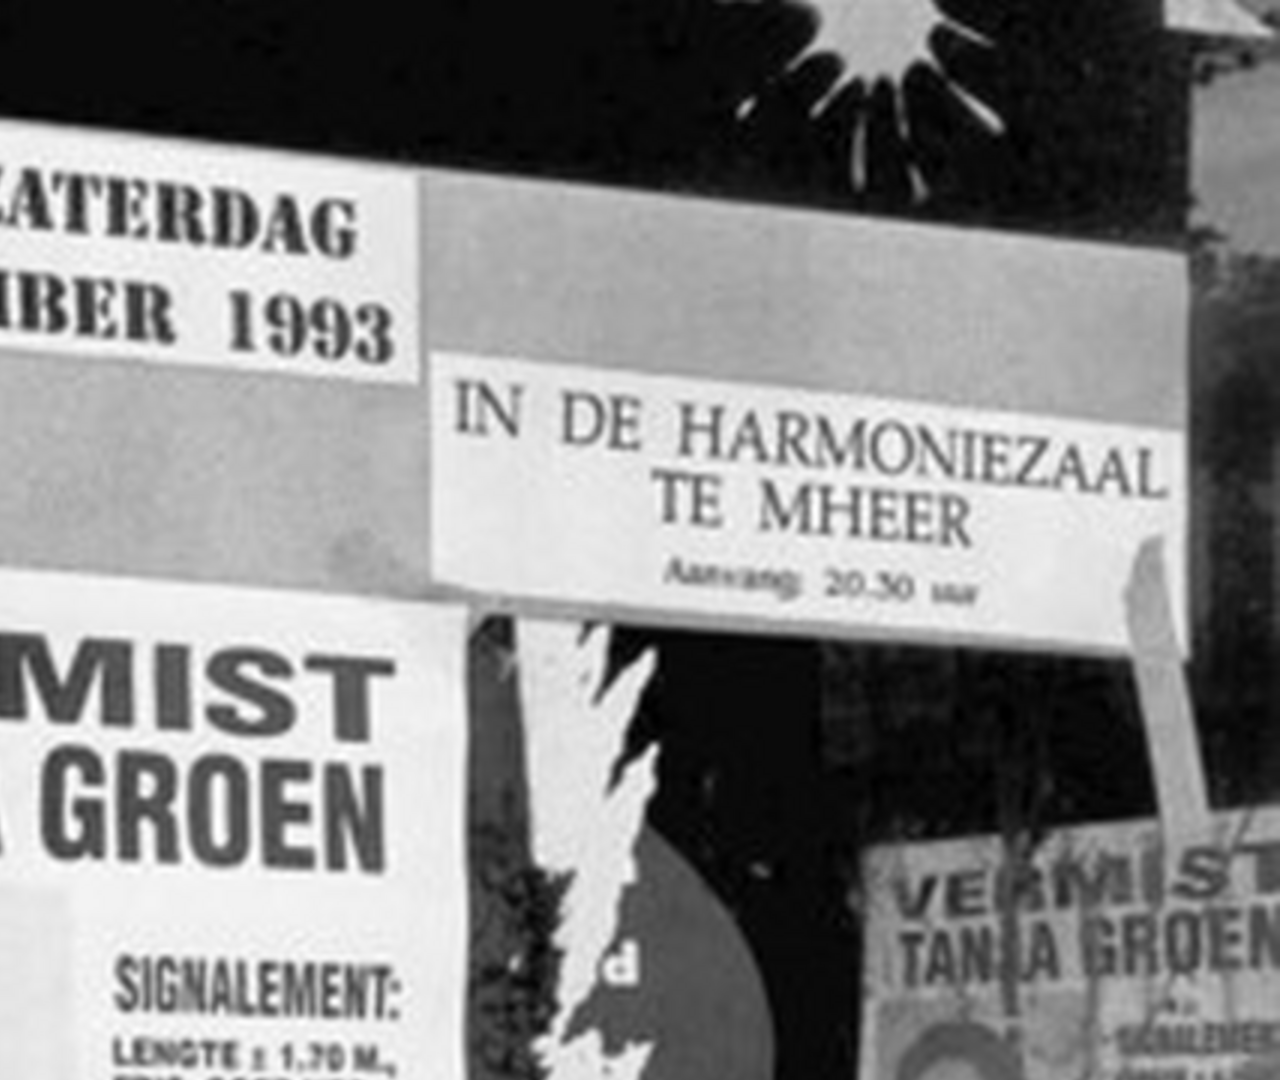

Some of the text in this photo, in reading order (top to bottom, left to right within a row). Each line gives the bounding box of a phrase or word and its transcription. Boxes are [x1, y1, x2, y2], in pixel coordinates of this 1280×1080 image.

[228, 289, 393, 364] 1993
[455, 380, 1168, 501] IN DE HARMONIEZAAL
[651, 470, 972, 548] TE MHEER
[824, 566, 913, 603] 20.30
[930, 578, 978, 608] uur
[40, 744, 386, 874] GROEN
[114, 954, 402, 1020] SIGNALEMENT:
[112, 1036, 239, 1070] LENGTE
